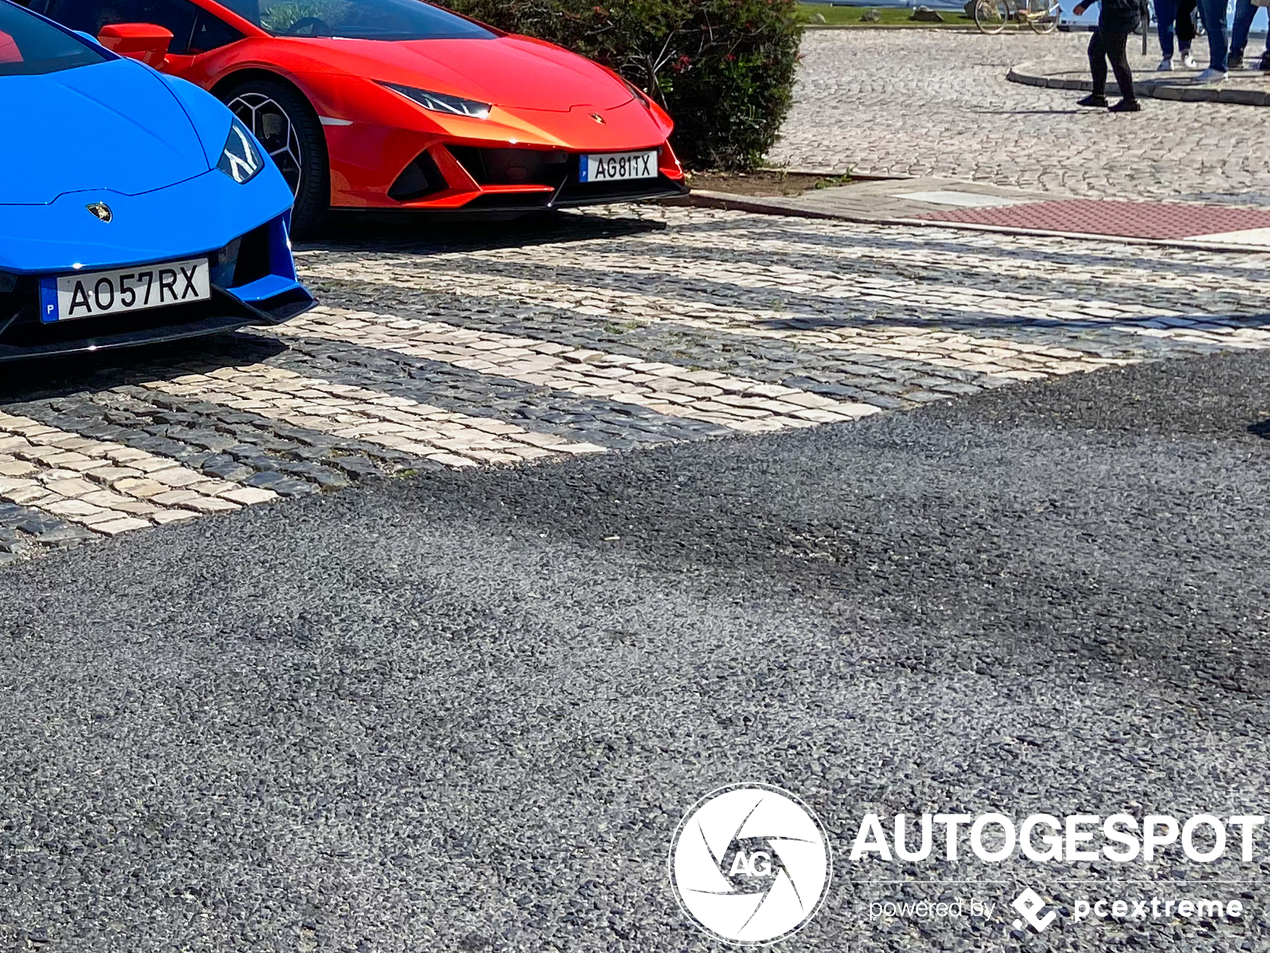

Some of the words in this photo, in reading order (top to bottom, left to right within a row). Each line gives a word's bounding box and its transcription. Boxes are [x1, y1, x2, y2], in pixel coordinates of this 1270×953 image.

[595, 155, 650, 179] AG81TX
[47, 304, 54, 315] P
[68, 265, 199, 315] AO57RX
